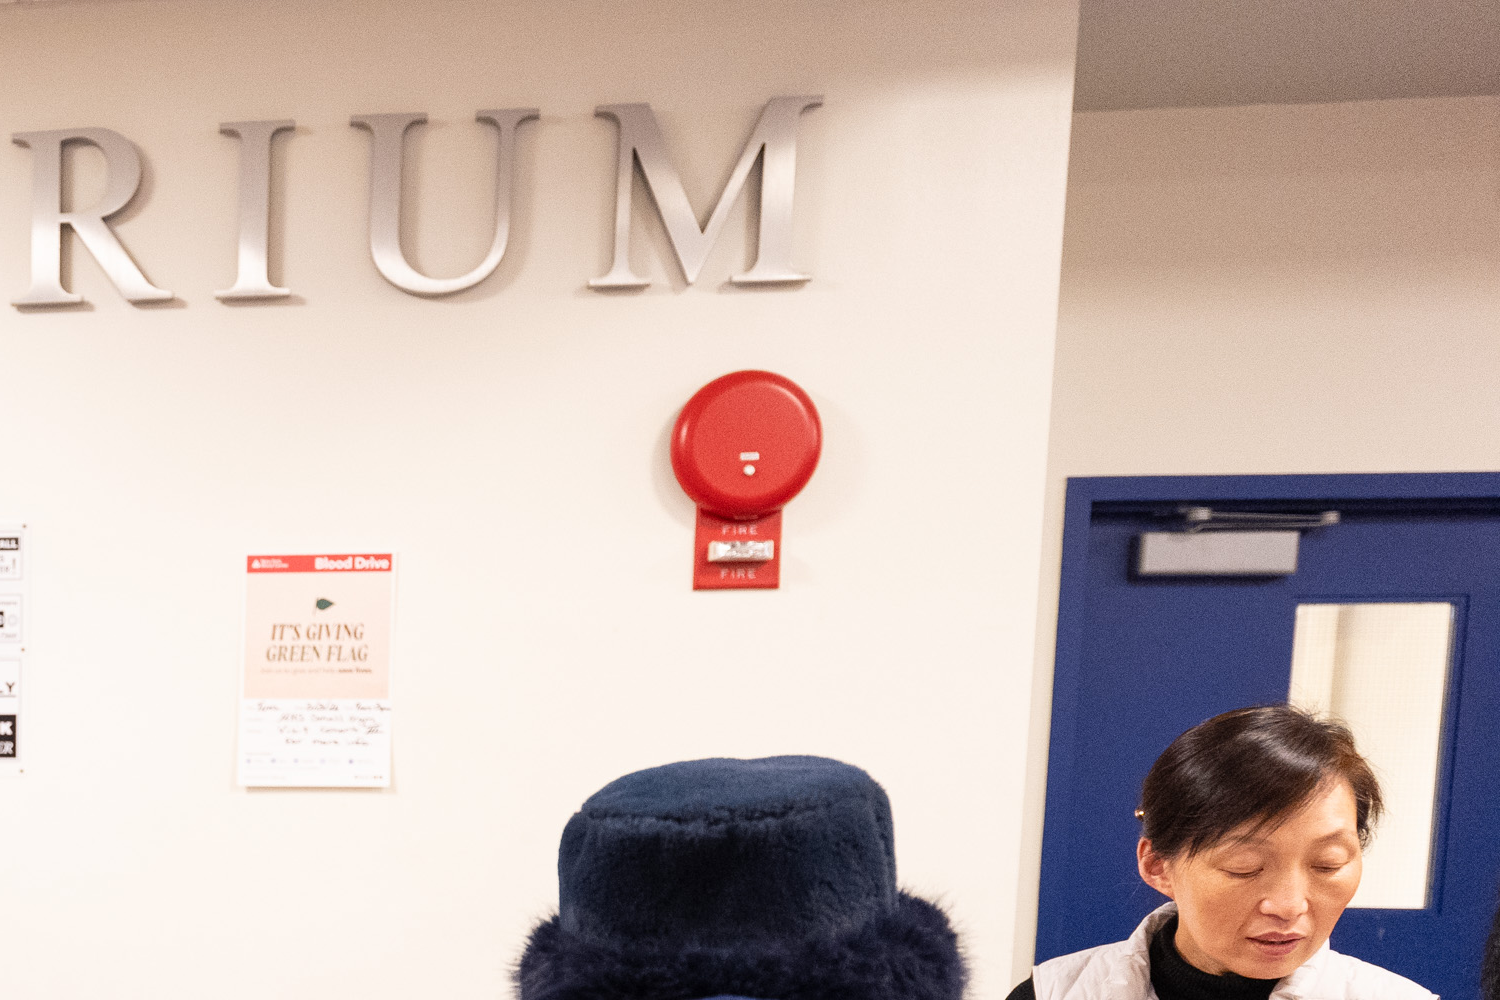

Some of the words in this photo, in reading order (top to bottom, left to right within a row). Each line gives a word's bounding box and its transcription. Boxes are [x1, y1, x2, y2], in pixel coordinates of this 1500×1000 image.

[722, 524, 758, 536] FIRE
[314, 556, 353, 570] Blood
[354, 556, 390, 570] Drive
[720, 568, 756, 579] FIRE
[271, 623, 301, 641] IT'S
[306, 623, 365, 641] GIVING
[266, 644, 320, 662] GREEN
[327, 644, 369, 662] FLAG
